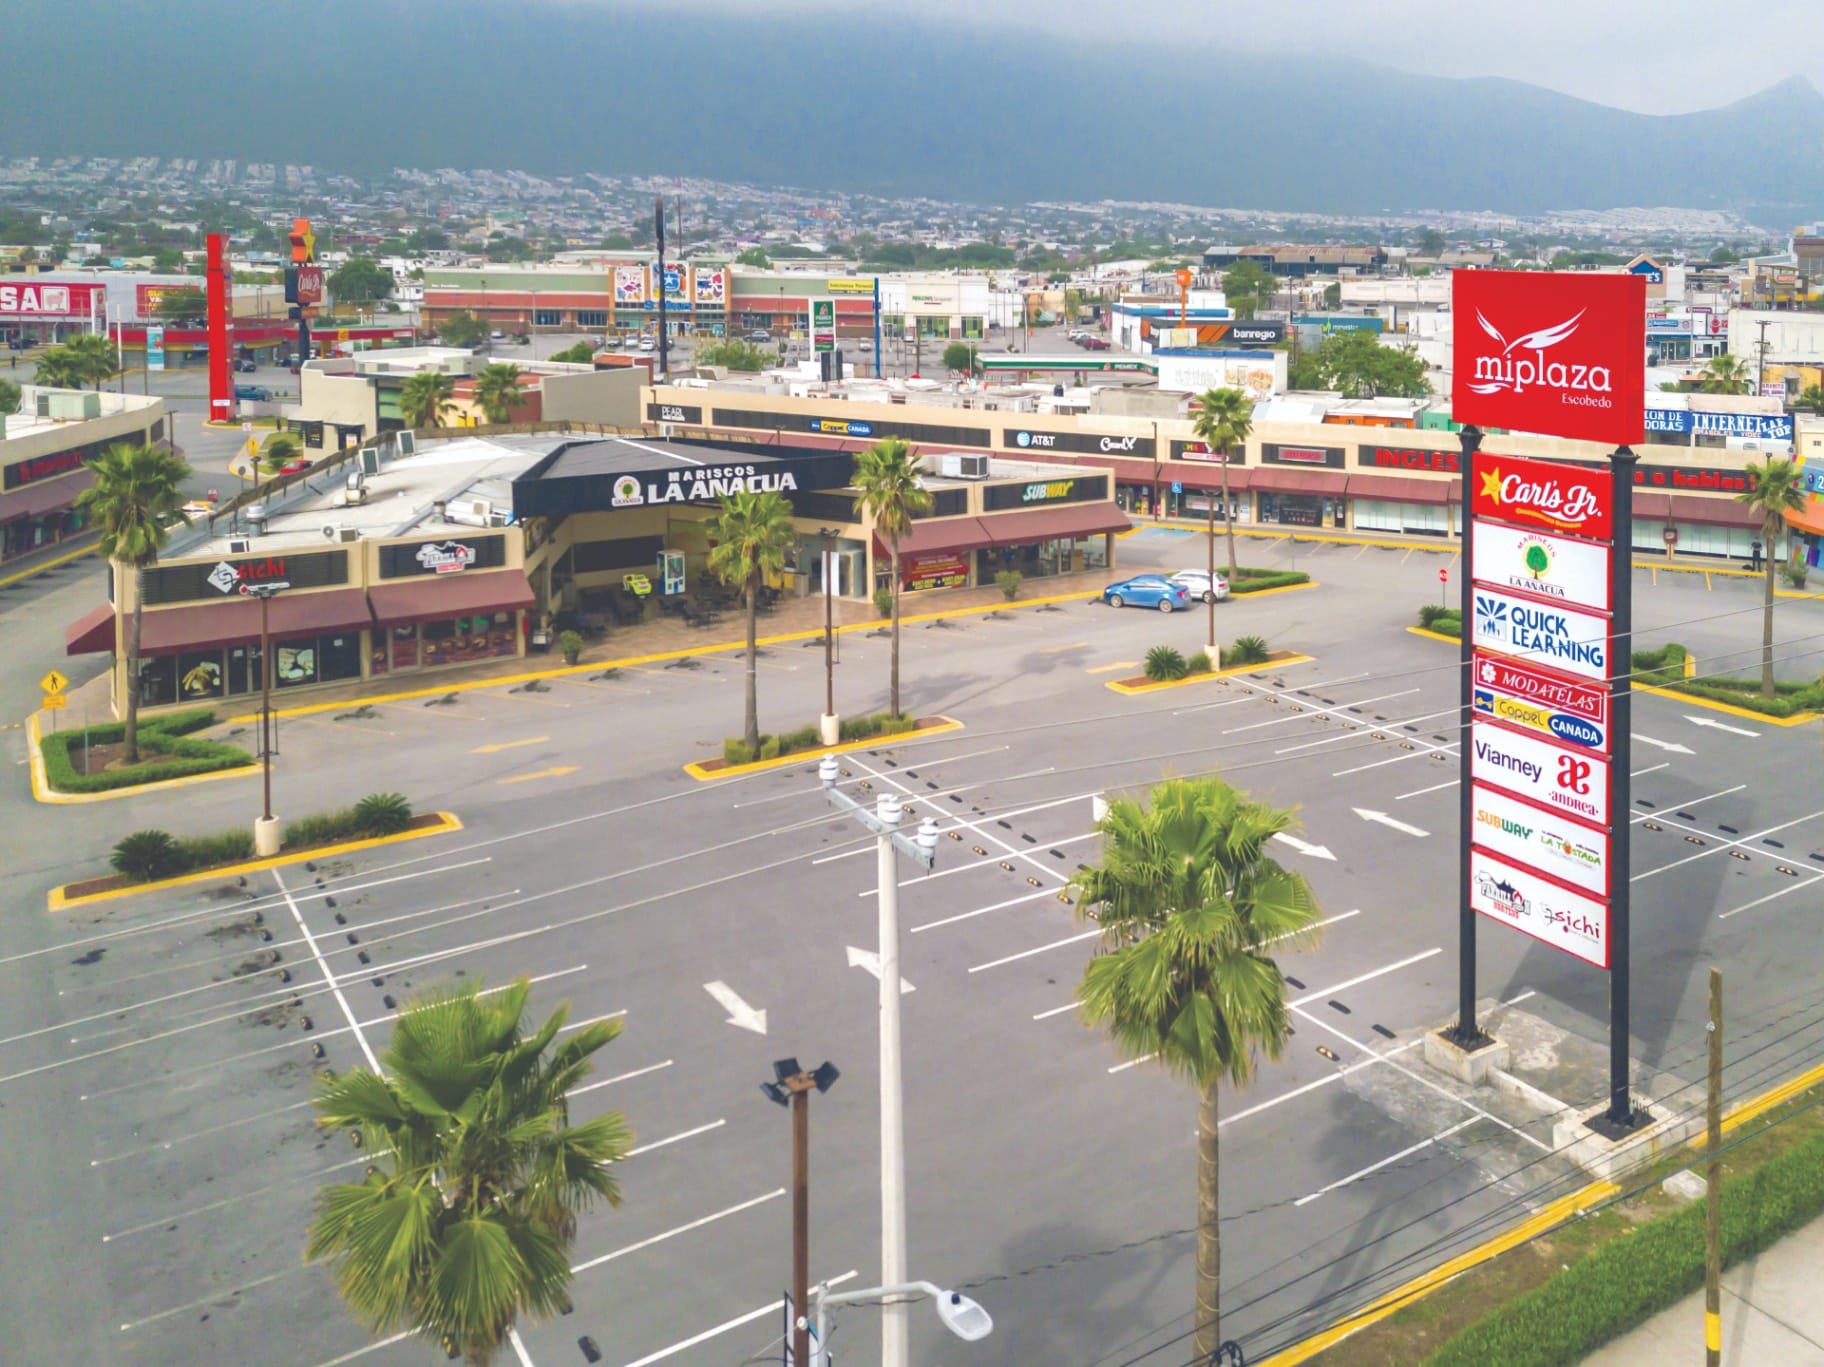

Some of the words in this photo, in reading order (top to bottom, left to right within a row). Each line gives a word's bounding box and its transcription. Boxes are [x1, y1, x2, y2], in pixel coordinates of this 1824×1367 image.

[1233, 328, 1276, 340] banregio
[1474, 349, 1612, 393] miplaza
[1562, 393, 1612, 408] Escobedo
[1669, 411, 1683, 421] DE
[1692, 413, 1762, 433] INTERNET
[847, 425, 870, 433] CANADA
[1768, 425, 1791, 439] TOP
[1031, 434, 1056, 447] AT&T
[668, 466, 755, 482] MARISCOS
[648, 483, 685, 503] LA
[689, 472, 798, 499] ANACUA
[1022, 480, 1074, 501] SUBWAY
[1500, 474, 1563, 509] Carl's
[1563, 485, 1602, 517] Jr.
[1517, 534, 1557, 558] MARISCOS
[1510, 577, 1521, 587] LA
[1524, 580, 1565, 597] ANACUA
[1511, 606, 1569, 638] QUICK
[1512, 626, 1604, 668] LEARNING
[1502, 672, 1594, 711] MODATELAS
[1500, 701, 1544, 726] Coppel
[1551, 719, 1598, 744] CANADA
[1475, 739, 1542, 783] Vianney
[1476, 809, 1533, 840] SUBWAY
[1540, 835, 1553, 847] LA
